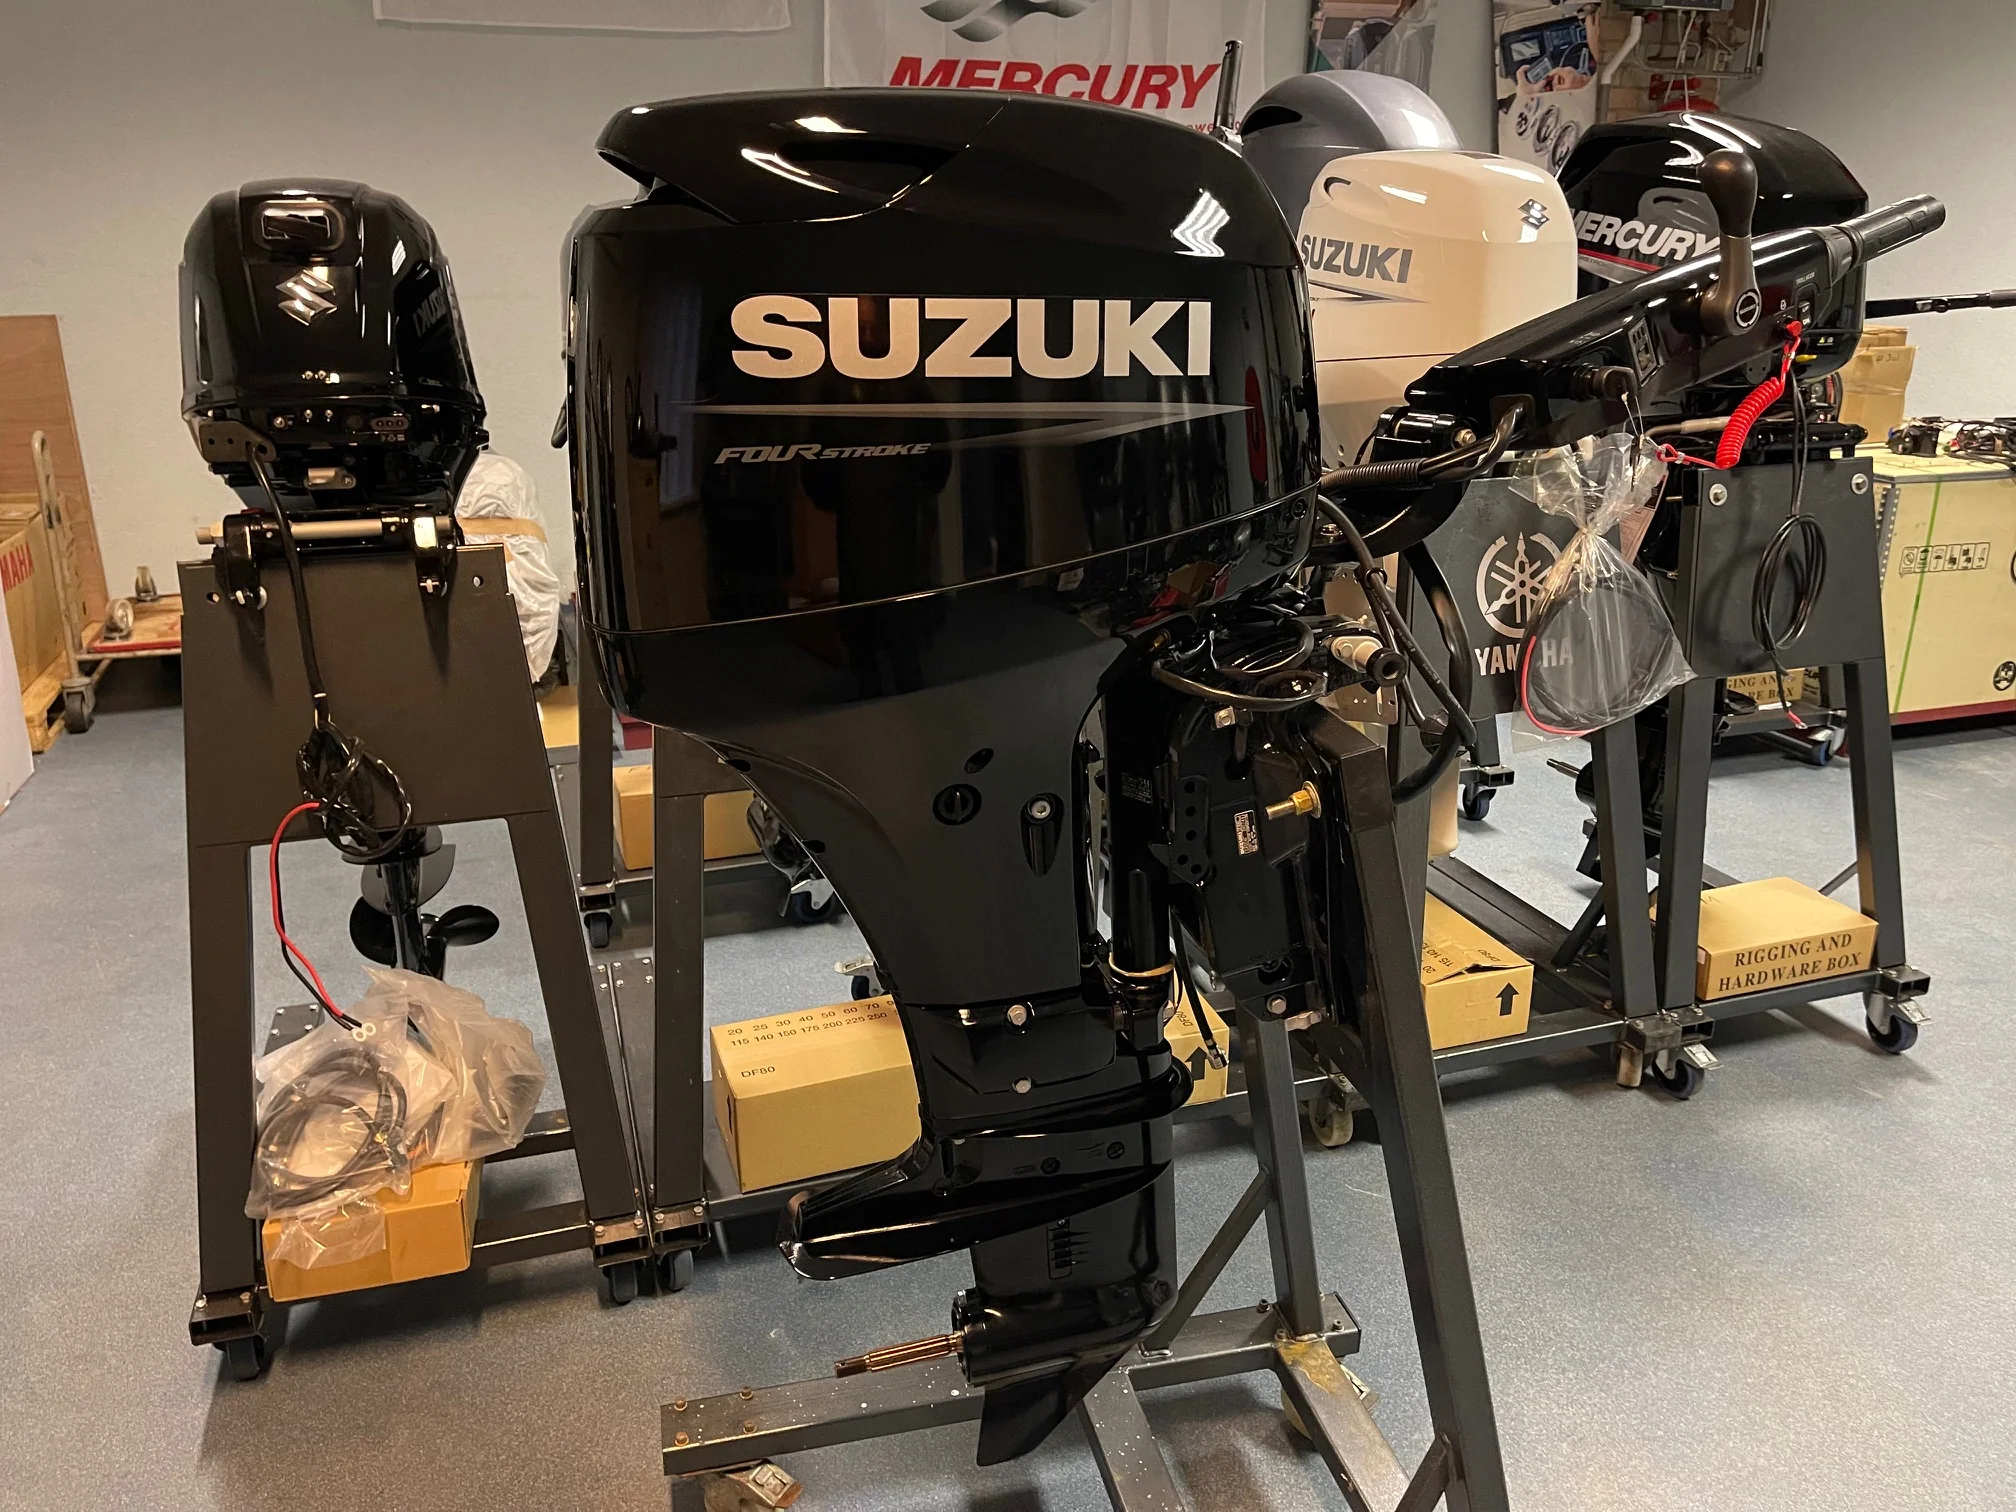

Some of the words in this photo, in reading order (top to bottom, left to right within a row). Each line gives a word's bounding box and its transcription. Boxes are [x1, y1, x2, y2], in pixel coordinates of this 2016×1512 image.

[889, 56, 1221, 109] MERCURY
[1300, 234, 1413, 284] SUZUKI
[730, 294, 1212, 379] SUZUKI
[1474, 637, 1574, 676] YAMHA
[1768, 686, 1795, 700] BX
[1734, 940, 1811, 968] RIGGING
[1815, 933, 1852, 953] AND
[1718, 960, 1822, 992] HARDWARE
[1826, 952, 1862, 971] BOX
[727, 1028, 743, 1036] 20
[752, 1023, 768, 1031] 25
[775, 1019, 791, 1027] 30
[821, 1010, 836, 1018] 50
[843, 1006, 858, 1015] 60
[864, 1002, 880, 1010] 70
[730, 1037, 750, 1046] 115
[754, 1033, 774, 1042] 140
[777, 1029, 797, 1037] 150
[801, 1024, 820, 1033] 175
[822, 1020, 843, 1029] 200
[845, 1016, 866, 1025] 225
[867, 1012, 888, 1020] 250
[741, 1065, 776, 1078] DF80
